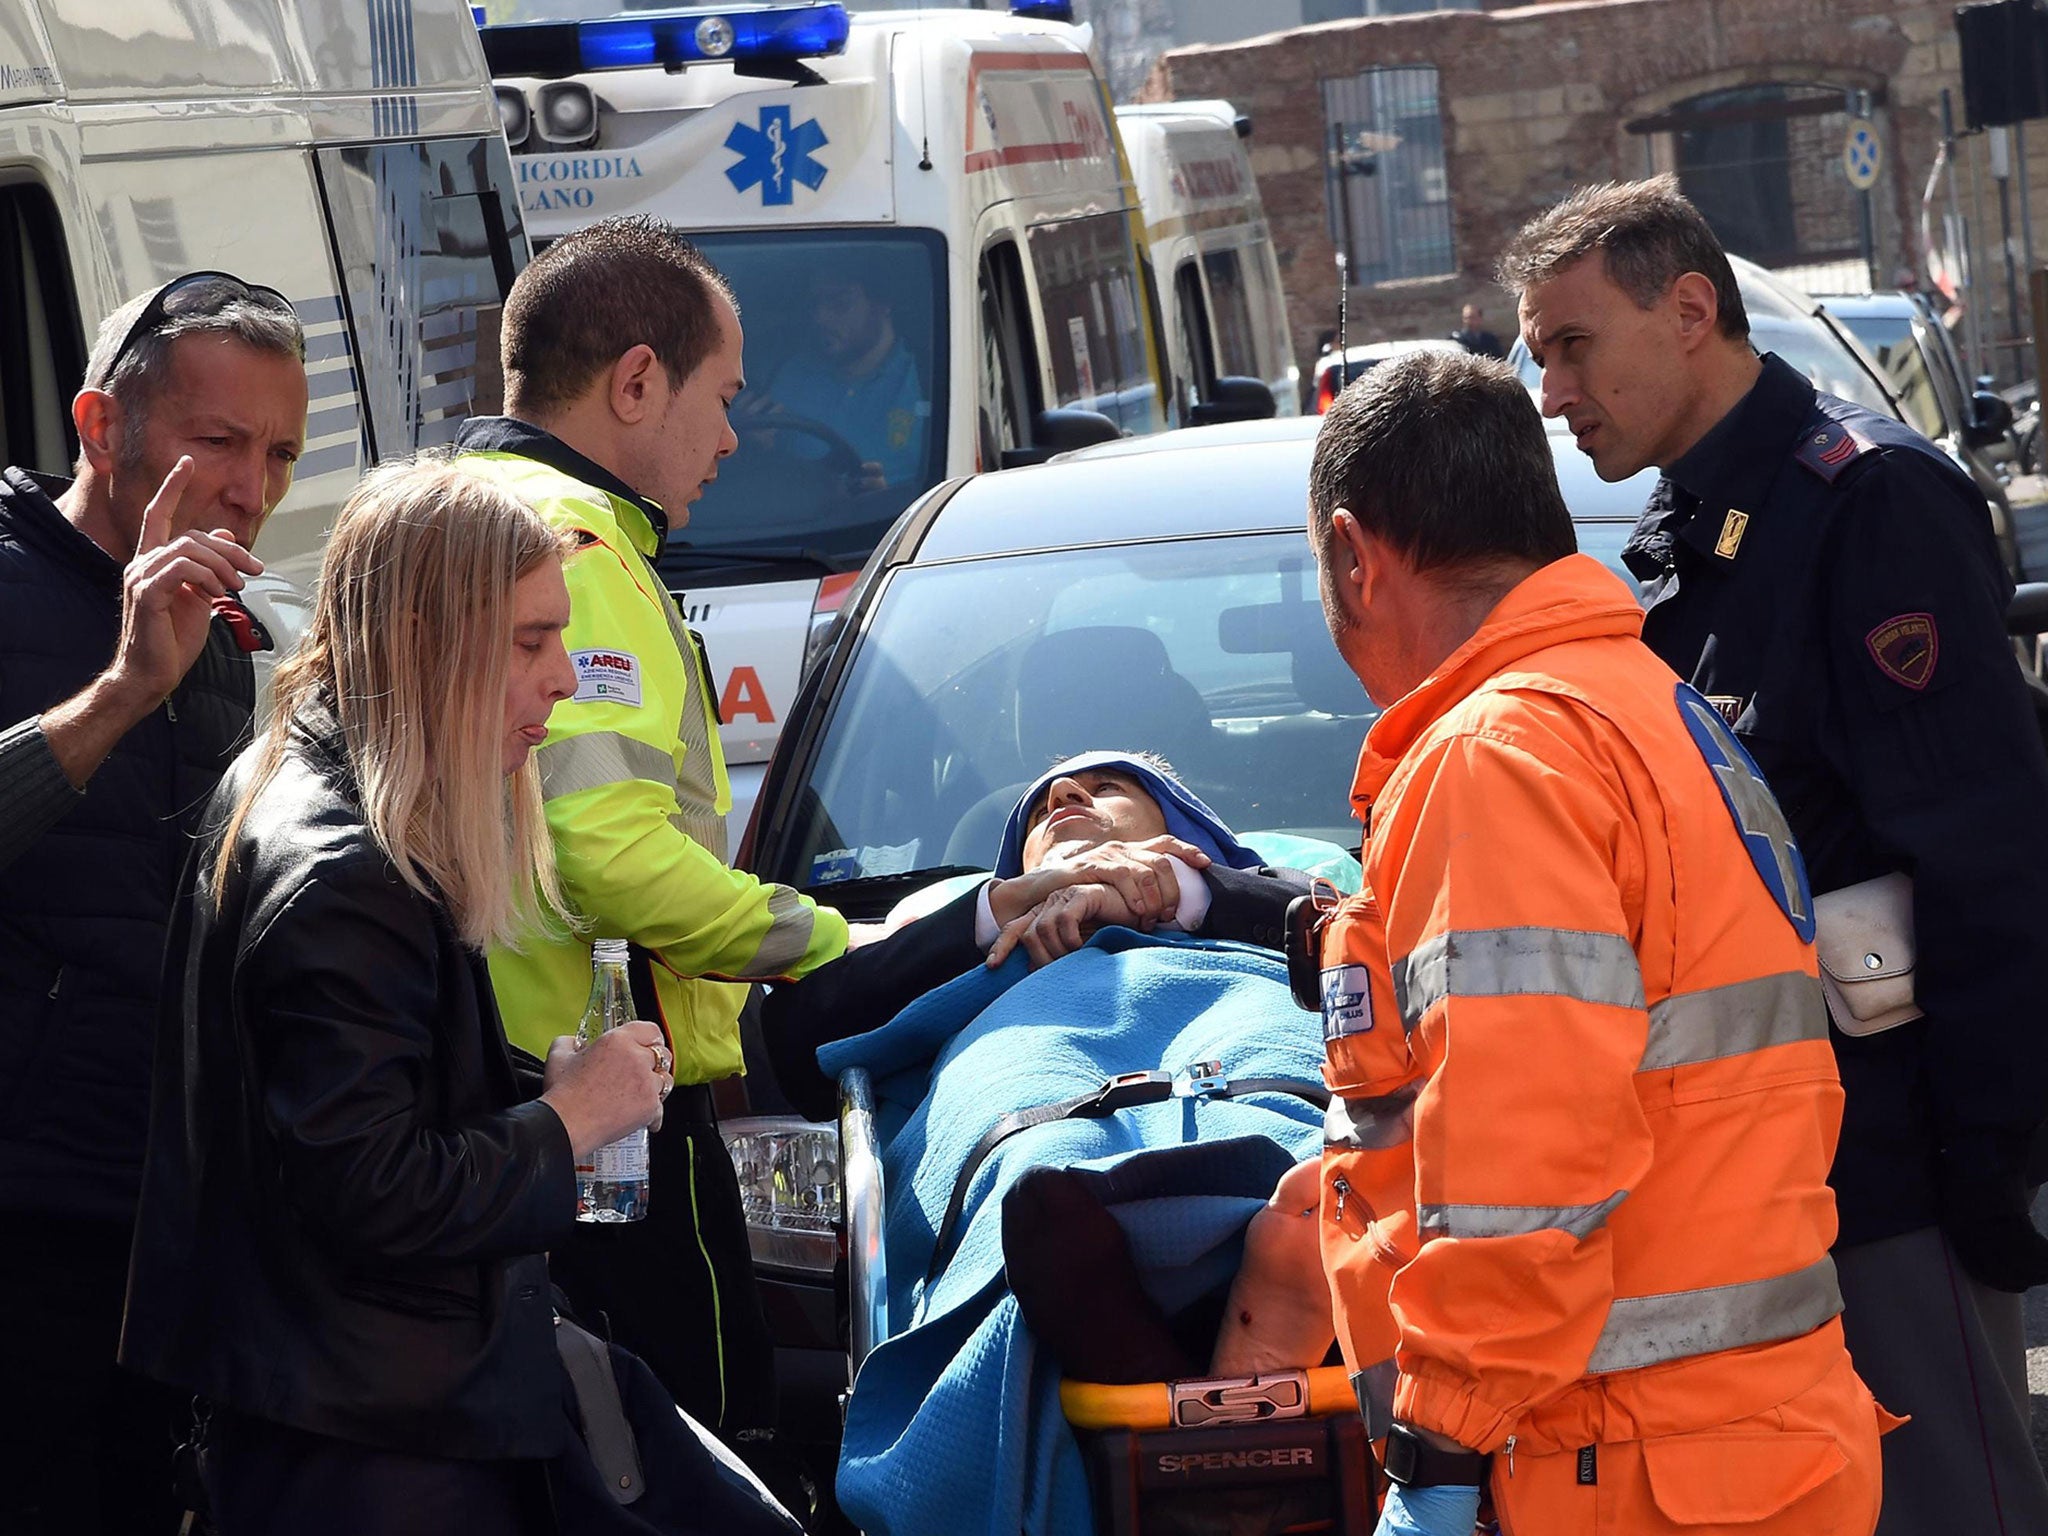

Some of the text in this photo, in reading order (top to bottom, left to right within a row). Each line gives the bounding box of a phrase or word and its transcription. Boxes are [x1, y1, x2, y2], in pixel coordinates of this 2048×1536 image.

[514, 157, 644, 183] ICORDIA
[519, 187, 594, 211] LANO
[590, 654, 632, 671] AREU
[1158, 1448, 1314, 1473] SPENCER
